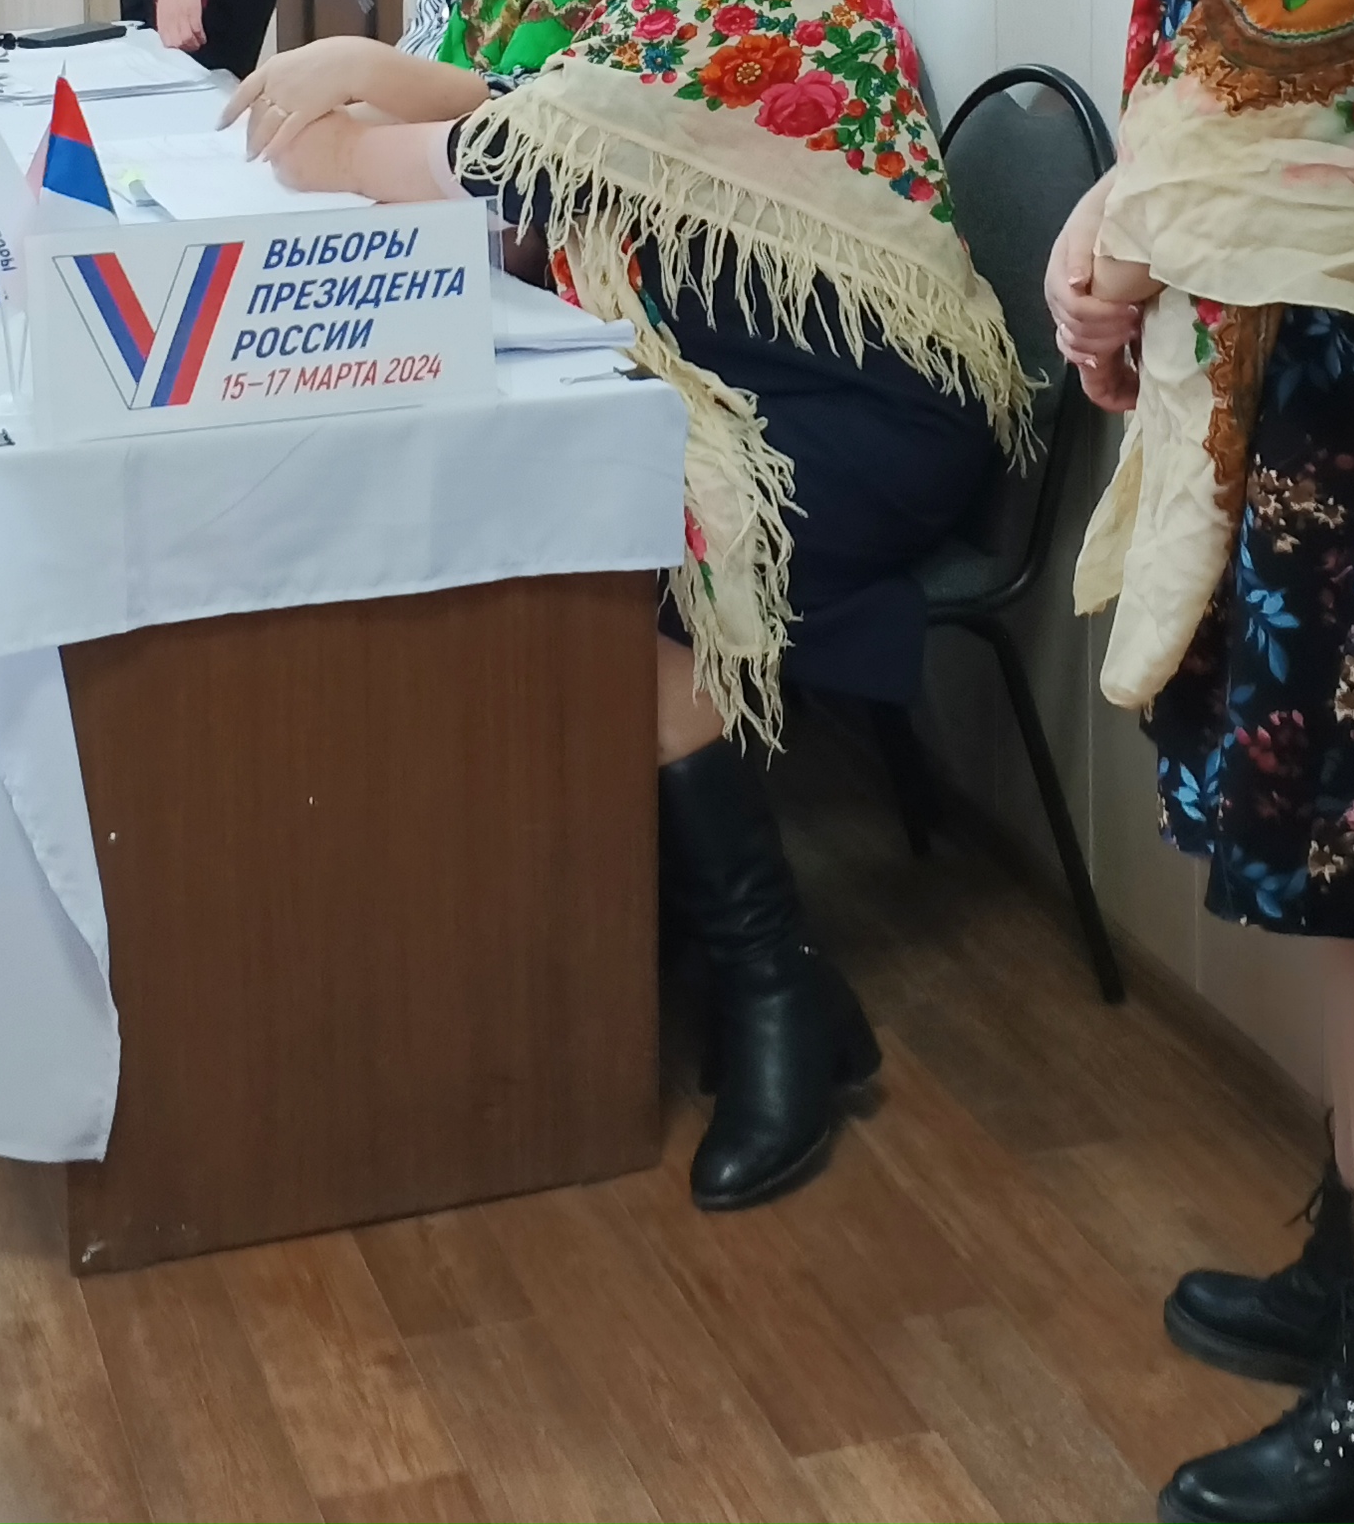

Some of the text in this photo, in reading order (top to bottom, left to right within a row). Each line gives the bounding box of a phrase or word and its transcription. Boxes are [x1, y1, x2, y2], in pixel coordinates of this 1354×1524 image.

[262, 227, 420, 270] ВЫБОРЫ
[246, 266, 467, 315] ПРЕЗИДЕНТА
[231, 318, 376, 362] РОССИИ
[293, 361, 377, 395] МАРТА
[382, 353, 444, 386] 2024
